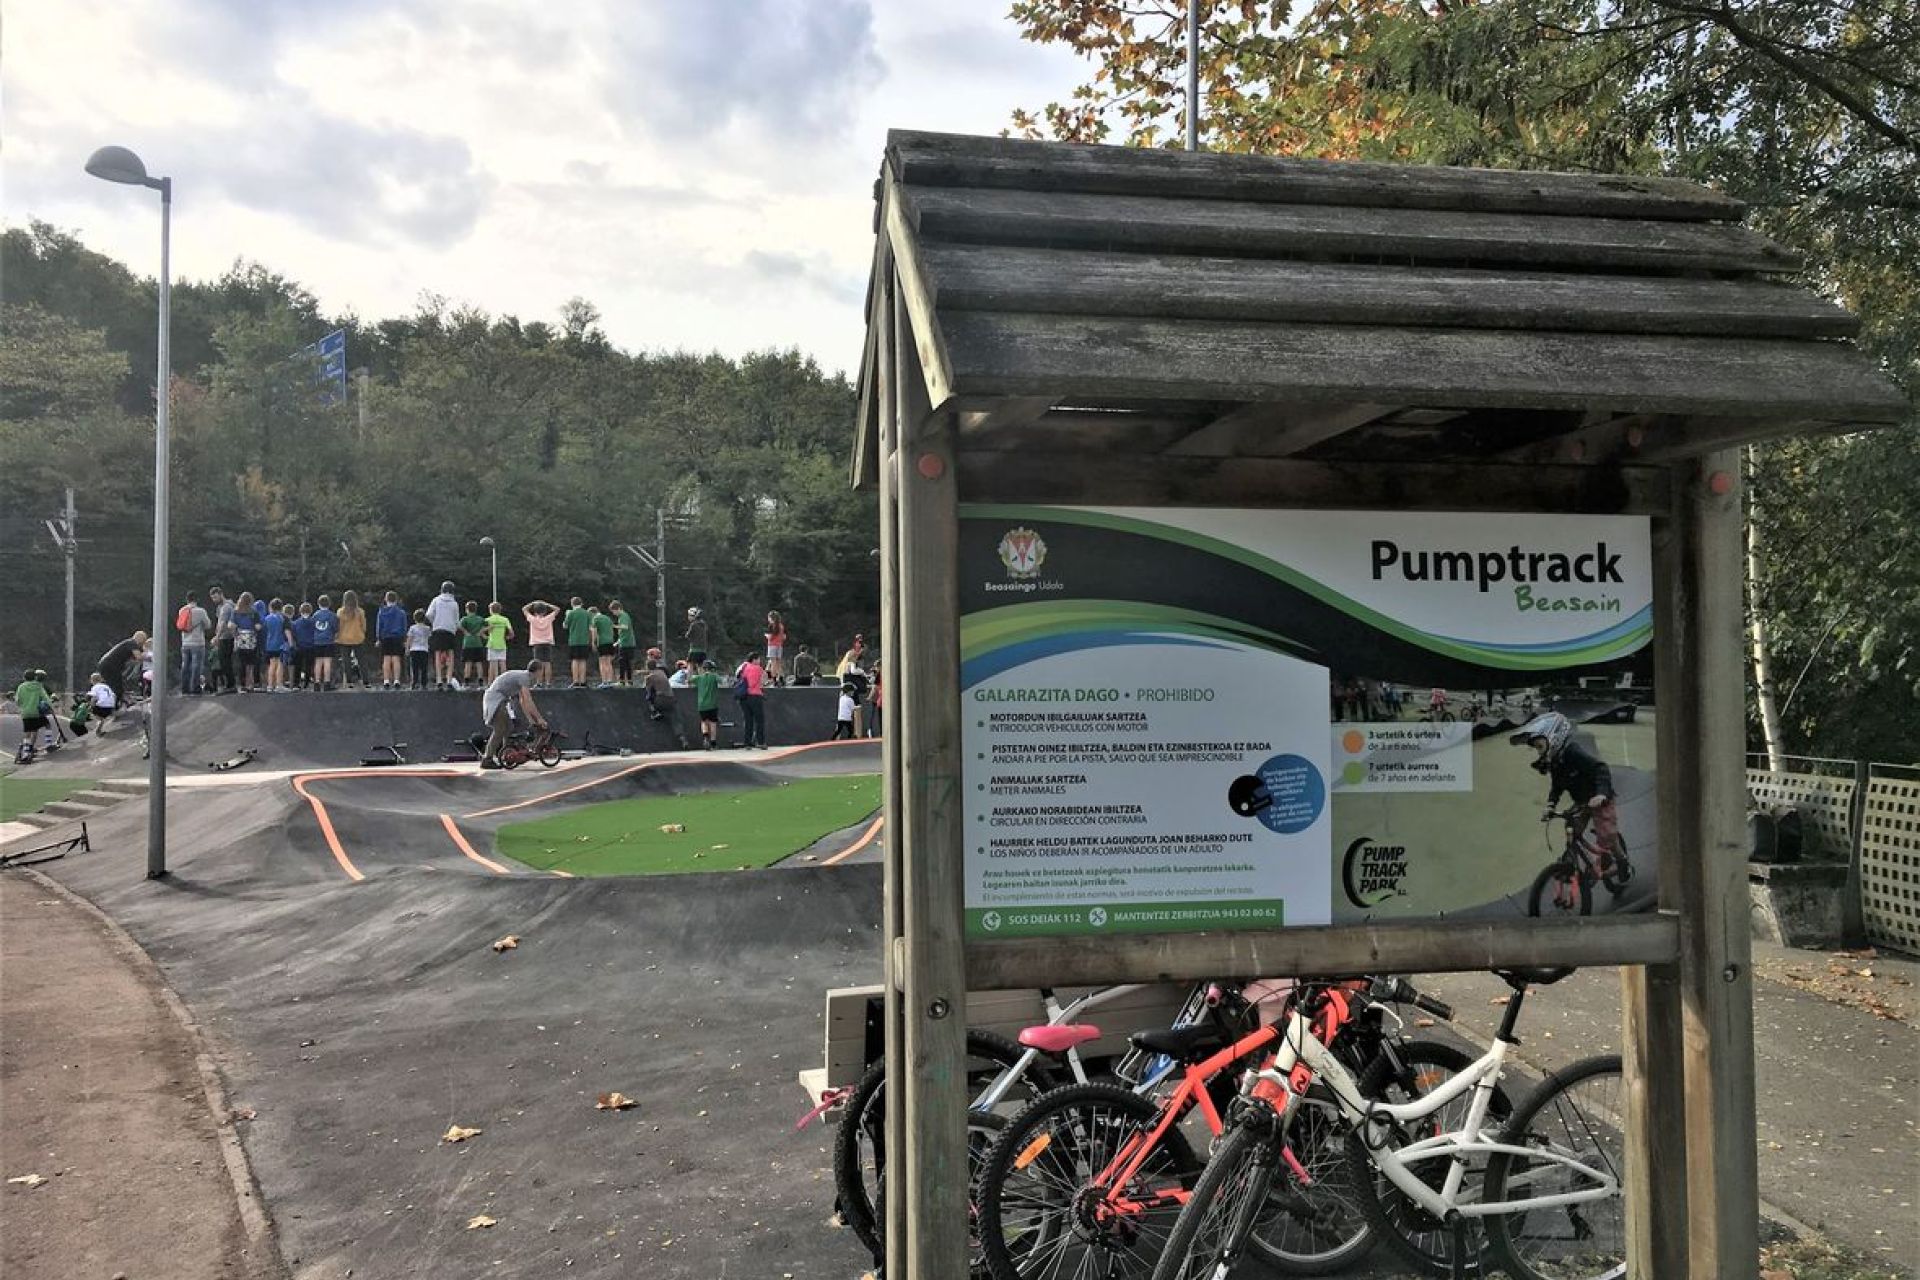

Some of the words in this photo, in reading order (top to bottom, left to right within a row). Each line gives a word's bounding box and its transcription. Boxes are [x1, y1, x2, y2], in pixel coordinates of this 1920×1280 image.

[1371, 540, 1625, 592] Pumptrack
[985, 582, 1036, 592] Beasaingo
[1514, 584, 1621, 613] Beasain
[974, 688, 1071, 701] GALARAZITA
[1075, 688, 1120, 701] DAGO
[1136, 688, 1215, 701] PROHIBIDO
[990, 713, 1045, 722] MOTORDUN
[1047, 712, 1104, 722] IBILGAILUAK
[1106, 712, 1147, 721] SARTZEA
[990, 723, 1045, 733] INTRODUCIR
[1095, 723, 1115, 732] CON
[1117, 722, 1148, 732] MOTOR
[1376, 731, 1405, 739] urtetik
[1407, 731, 1412, 739] 6
[992, 744, 1036, 753] PISTETAN
[1038, 744, 1066, 753] OINEZ
[1112, 743, 1146, 752] BALDIN
[1149, 743, 1164, 751] ETA
[1166, 742, 1231, 751] EZINBESTEKOA
[1234, 742, 1245, 751] EZ
[1246, 742, 1272, 751] BADA
[992, 754, 1025, 763] ANDAR
[1026, 754, 1032, 763] A
[1034, 754, 1047, 763] PIE
[1050, 754, 1067, 763] POR
[1069, 754, 1080, 763] LA
[1109, 754, 1137, 762] SALVO
[1138, 753, 1156, 762] QUE
[1158, 753, 1174, 762] SEA
[1176, 752, 1244, 762] IMPRESCINDIBLE
[1369, 763, 1374, 771] 7
[1376, 762, 1405, 771] urtetik
[991, 775, 1043, 785] ANIMALIAK
[1045, 775, 1087, 784] SARTZEA
[1368, 774, 1379, 782] de
[1381, 774, 1386, 782] 7
[1422, 774, 1456, 782] adelante
[990, 786, 1020, 795] METER
[1021, 785, 1066, 794] ANIMALES
[992, 806, 1038, 816] AURKAKO
[1040, 806, 1101, 815] NORABIDEAN
[1103, 805, 1143, 814] IBILTZEA
[990, 817, 1034, 826] CIRCULAR
[1035, 817, 1047, 826] EN
[1097, 815, 1148, 825] CONTRARIA
[990, 838, 1035, 847] HAURREK
[1036, 837, 1068, 847] HELDU
[1070, 837, 1099, 846] BATEK
[1101, 836, 1157, 845] LAGUNDUTA
[1159, 835, 1184, 843] JOAN
[1185, 834, 1228, 843] BEHARKO
[1229, 834, 1253, 842] DUTE
[990, 849, 1008, 858] LOS
[1010, 848, 1037, 857] NIÑOS
[1082, 848, 1090, 856] IR
[1092, 846, 1159, 855] ACOMPAÑADOS
[1161, 846, 1173, 854] DE
[1174, 845, 1187, 854] UN
[1189, 844, 1224, 853] ADULTO
[1362, 846, 1405, 861] PUMP
[1361, 862, 1408, 877] TRACK
[1360, 879, 1398, 893] PARK
[1008, 915, 1029, 925] SOS
[1030, 914, 1062, 925] DEIAK
[1064, 913, 1082, 923] 112
[1114, 911, 1169, 922] MANTENTZE
[1171, 909, 1221, 920] ZERBITZUA
[1239, 909, 1251, 918] 02
